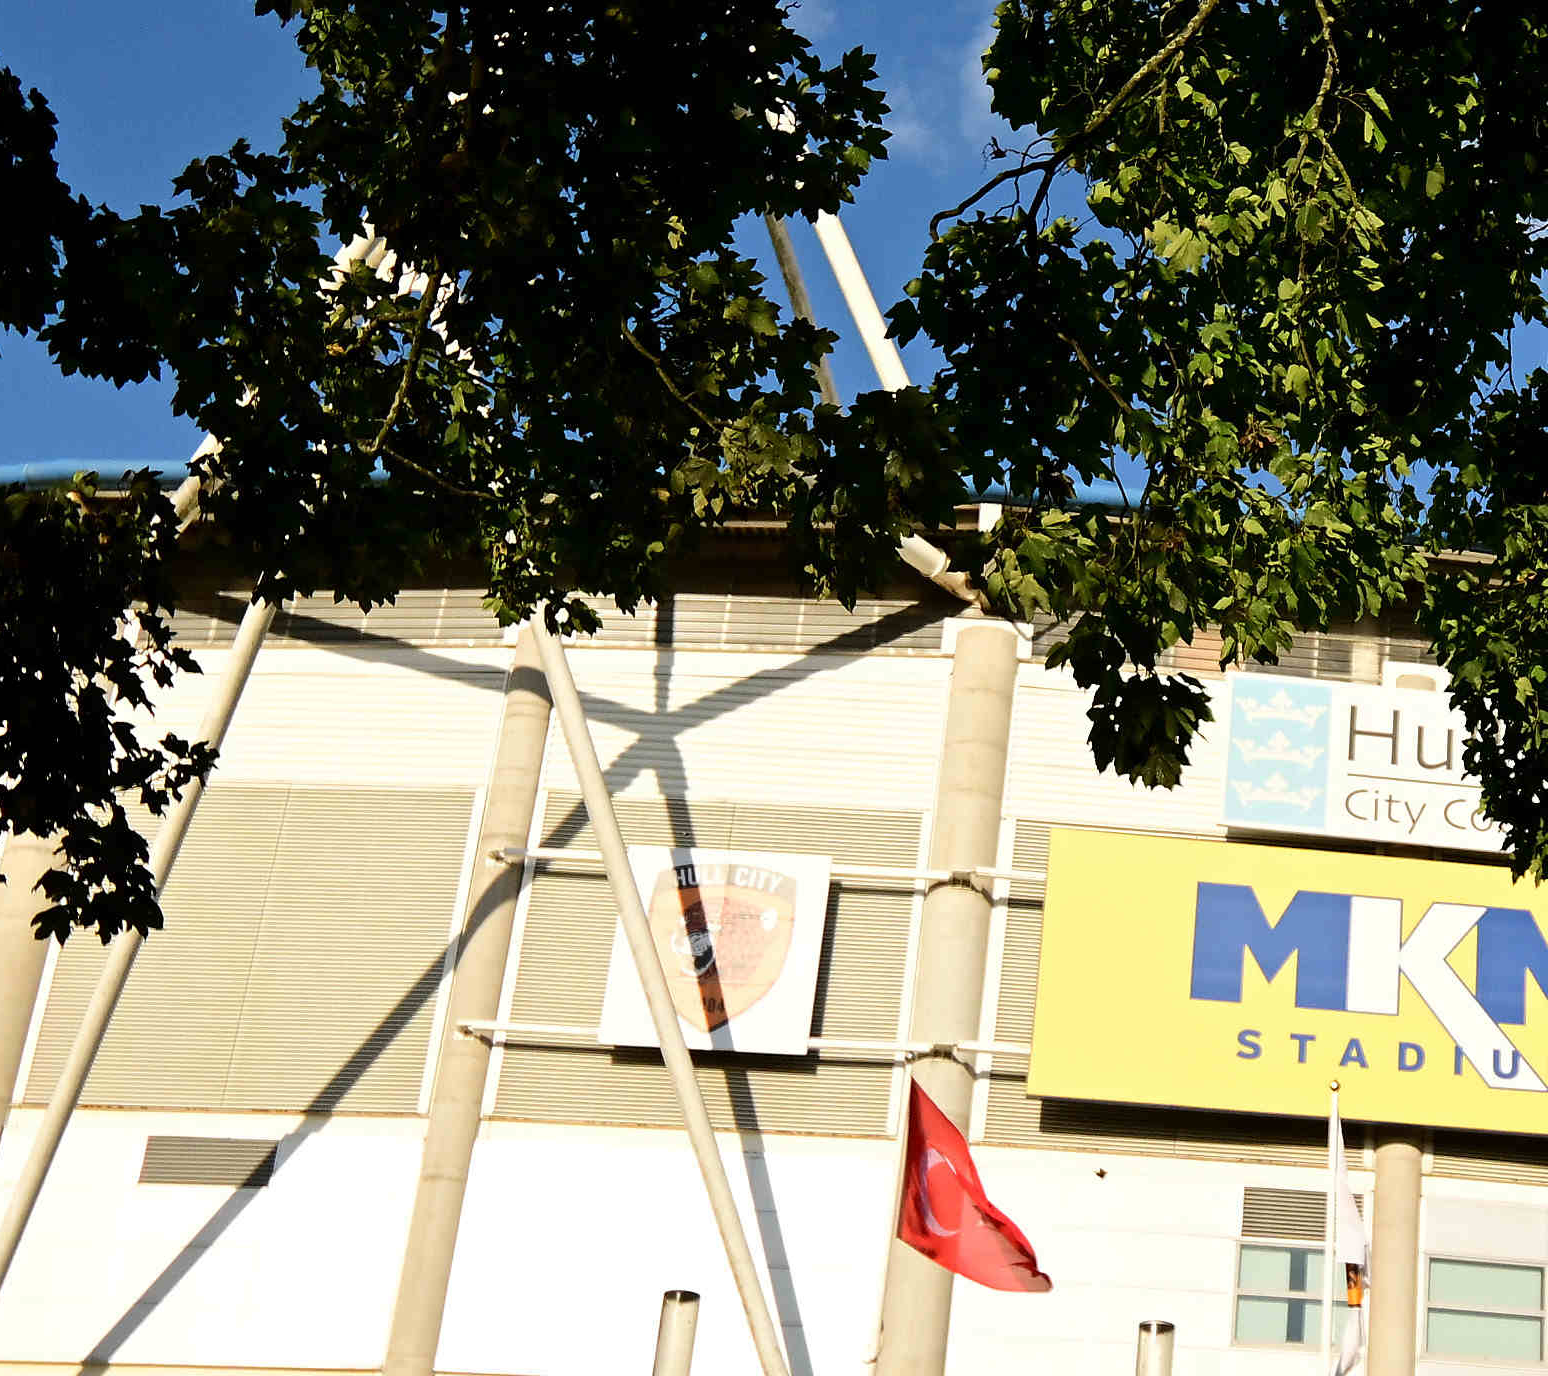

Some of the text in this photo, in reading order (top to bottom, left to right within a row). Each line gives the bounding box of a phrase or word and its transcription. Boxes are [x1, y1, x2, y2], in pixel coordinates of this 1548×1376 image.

[1348, 704, 1453, 770] Hu
[1345, 789, 1427, 834] City
[734, 866, 783, 892] CITY
